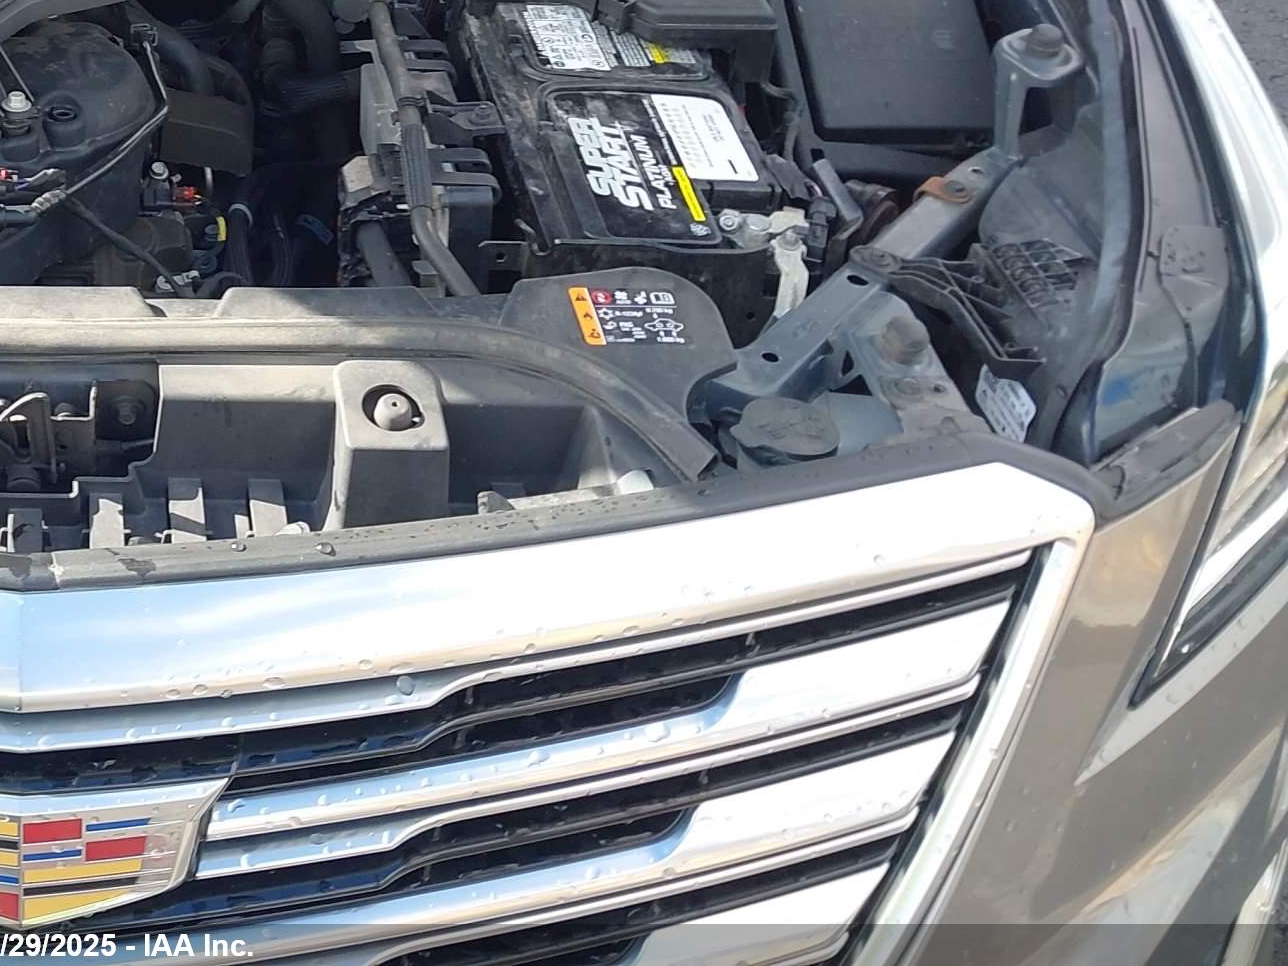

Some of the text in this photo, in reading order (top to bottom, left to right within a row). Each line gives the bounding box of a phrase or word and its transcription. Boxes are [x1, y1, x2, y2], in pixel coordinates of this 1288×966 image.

[568, 116, 611, 196] SUPER
[599, 124, 655, 211] START
[630, 134, 678, 209] PLATINUM
